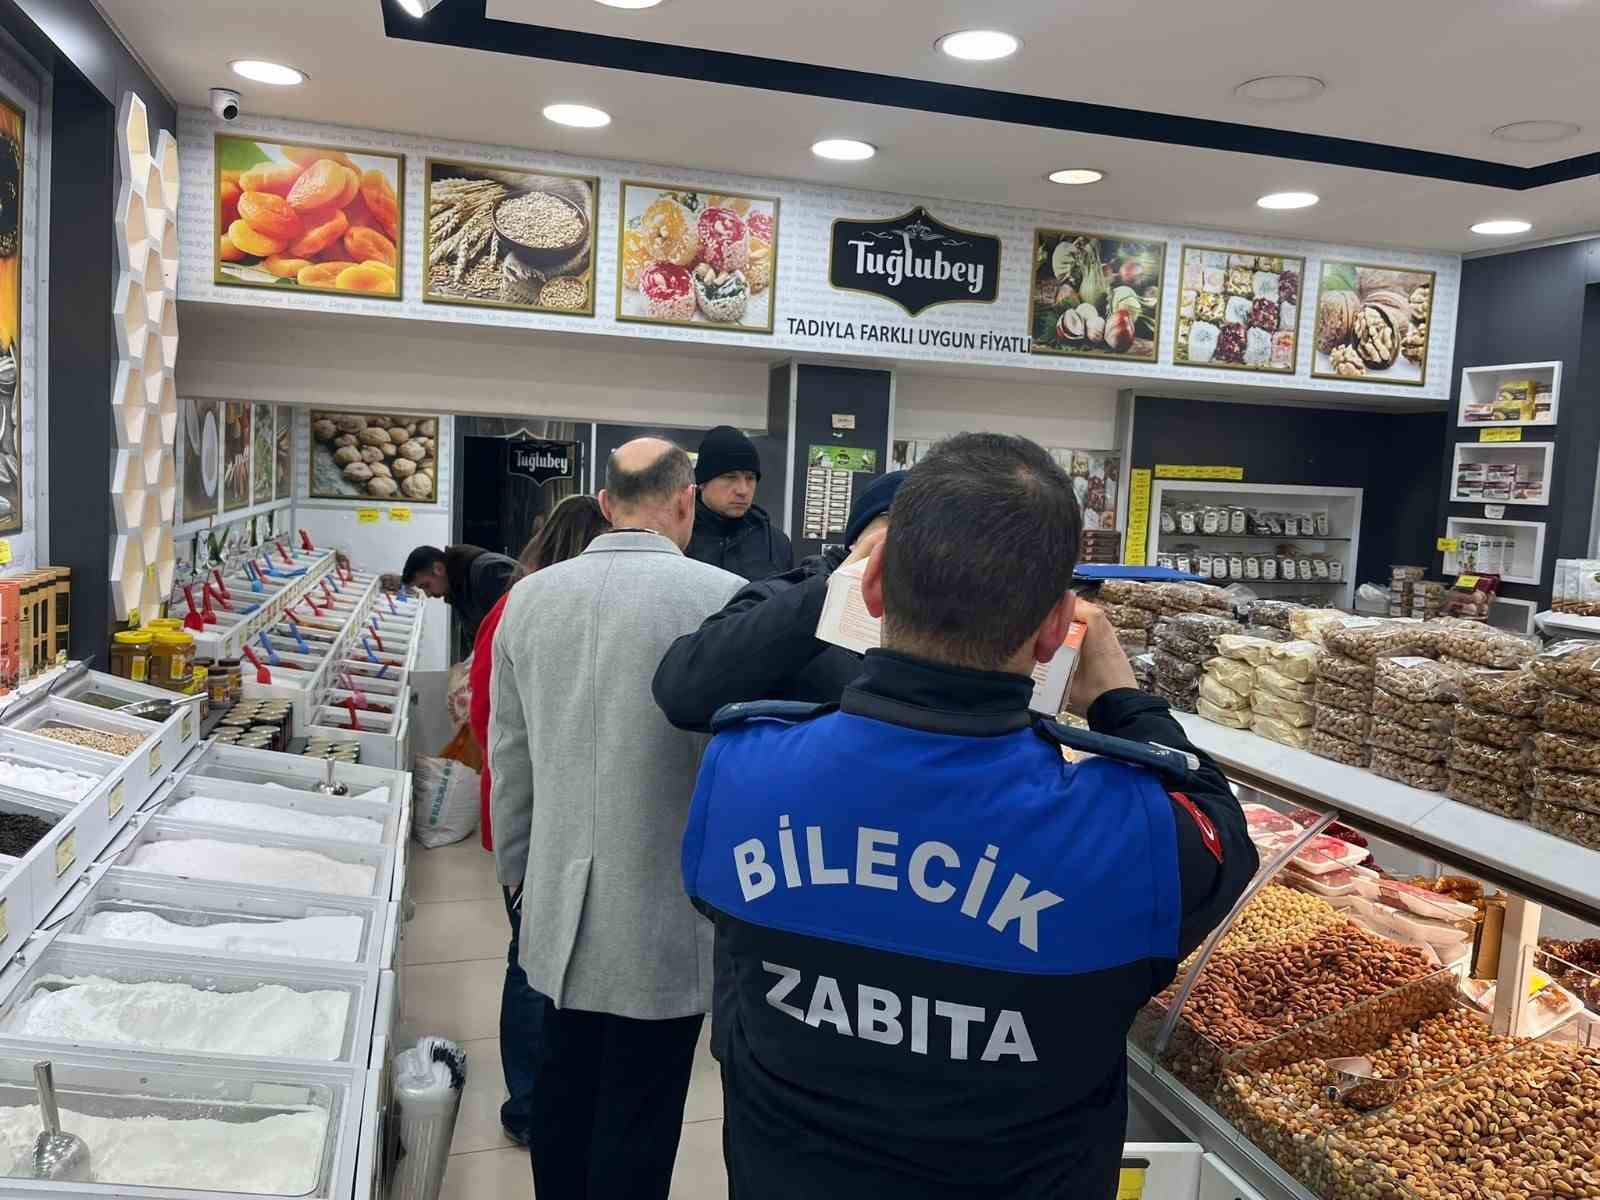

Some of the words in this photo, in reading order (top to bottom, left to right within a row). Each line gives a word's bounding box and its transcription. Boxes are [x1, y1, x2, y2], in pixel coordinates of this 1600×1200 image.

[848, 233, 984, 294] Tuğlubey
[787, 318, 855, 339] TADIYLA
[860, 324, 913, 345] FARKLI
[919, 329, 976, 350] UYGUN
[980, 333, 1032, 354] FİYATLI
[732, 814, 1064, 953] BİLECİK
[761, 960, 1038, 1062] ZABITA
